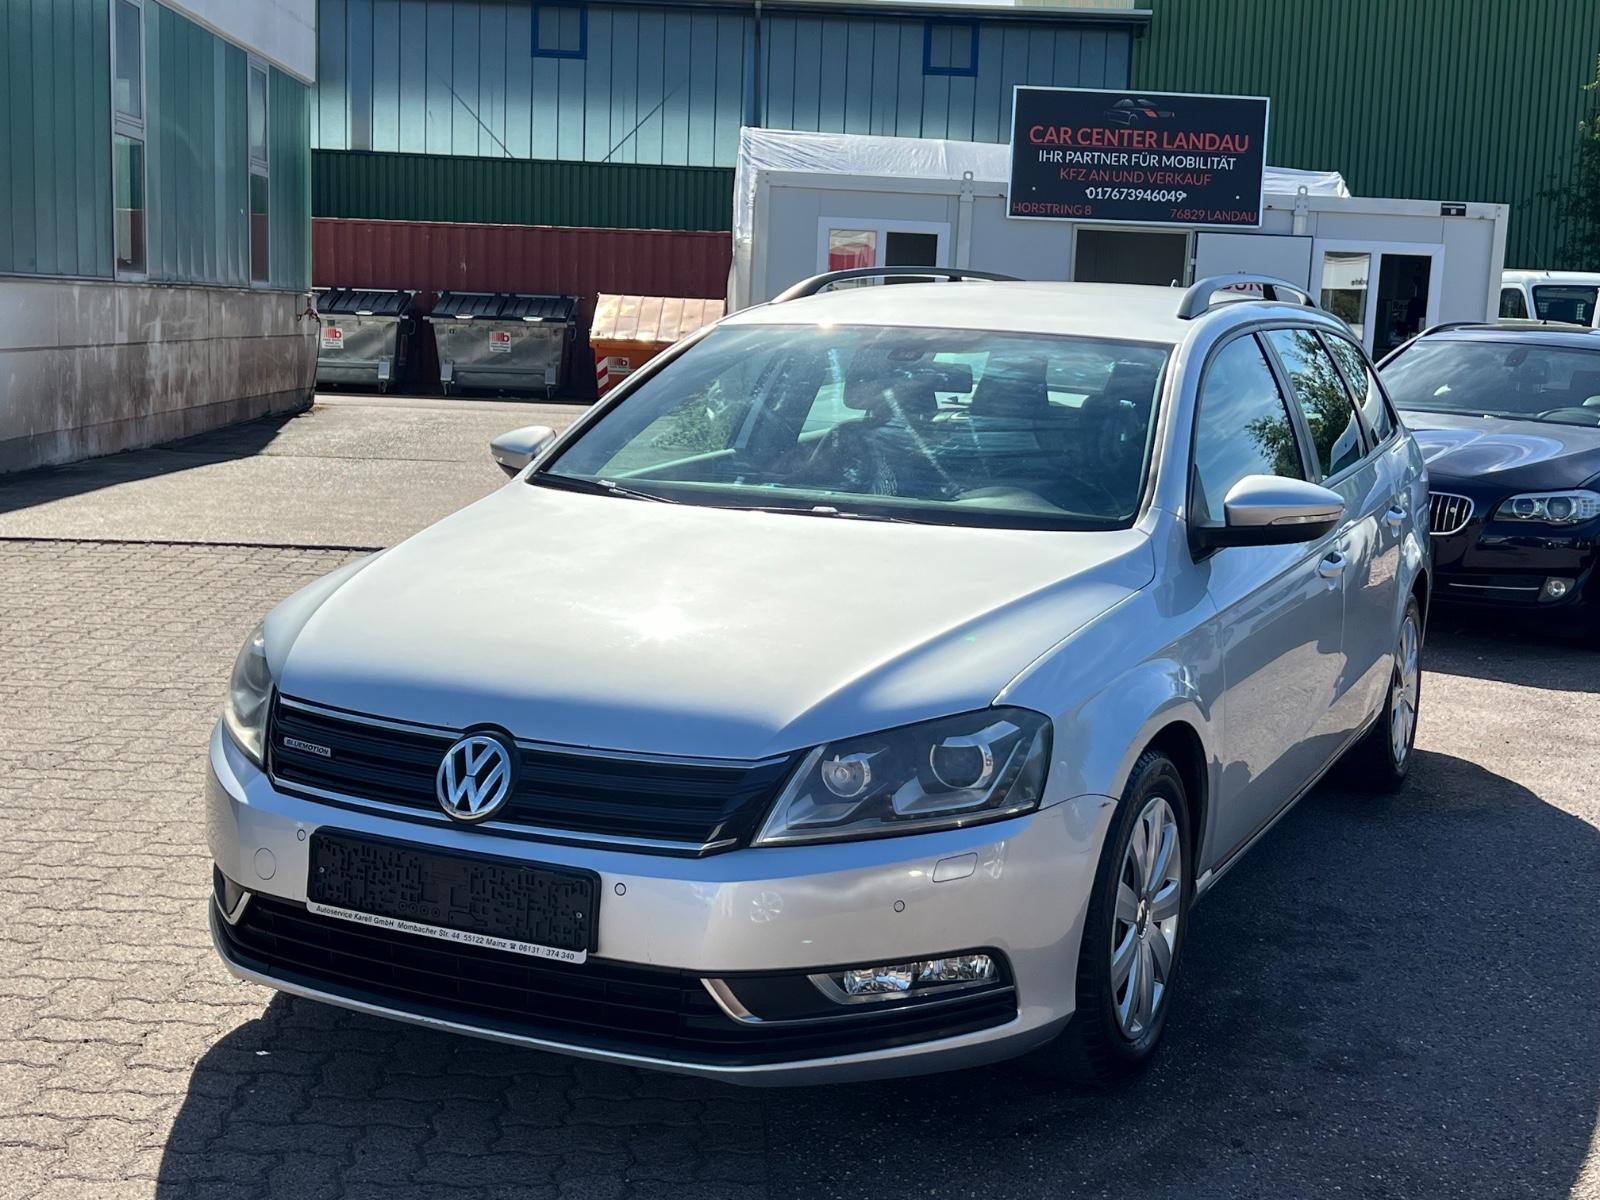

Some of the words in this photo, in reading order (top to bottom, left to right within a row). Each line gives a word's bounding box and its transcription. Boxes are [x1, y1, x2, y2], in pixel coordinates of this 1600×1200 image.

[1029, 125, 1072, 144] CAR
[1077, 127, 1157, 148] CENTER
[1163, 131, 1249, 151] LANDAU
[1038, 149, 1062, 162] IHR
[1065, 151, 1128, 165] PARTNER
[1131, 152, 1159, 167] FÜR
[1161, 155, 1237, 170] MOBILITÄT
[1060, 167, 1087, 181] KFZ
[1088, 169, 1110, 183] AN
[1112, 170, 1144, 183] UND
[1147, 171, 1212, 186] VERKAUF
[1086, 187, 1185, 202] 017673946049
[1012, 202, 1082, 215] HORSTRING
[1084, 205, 1092, 215] 8
[1169, 208, 1206, 219] 76829
[1207, 210, 1257, 222] LANDAU
[316, 905, 353, 919] Autoservice
[374, 917, 394, 927] GmbH
[397, 922, 437, 935] Mombacher
[463, 934, 484, 944] 55122
[485, 938, 507, 948] Mainz
[518, 944, 540, 954] 06131
[546, 949, 560, 957] 374
[560, 951, 575, 960] 340
